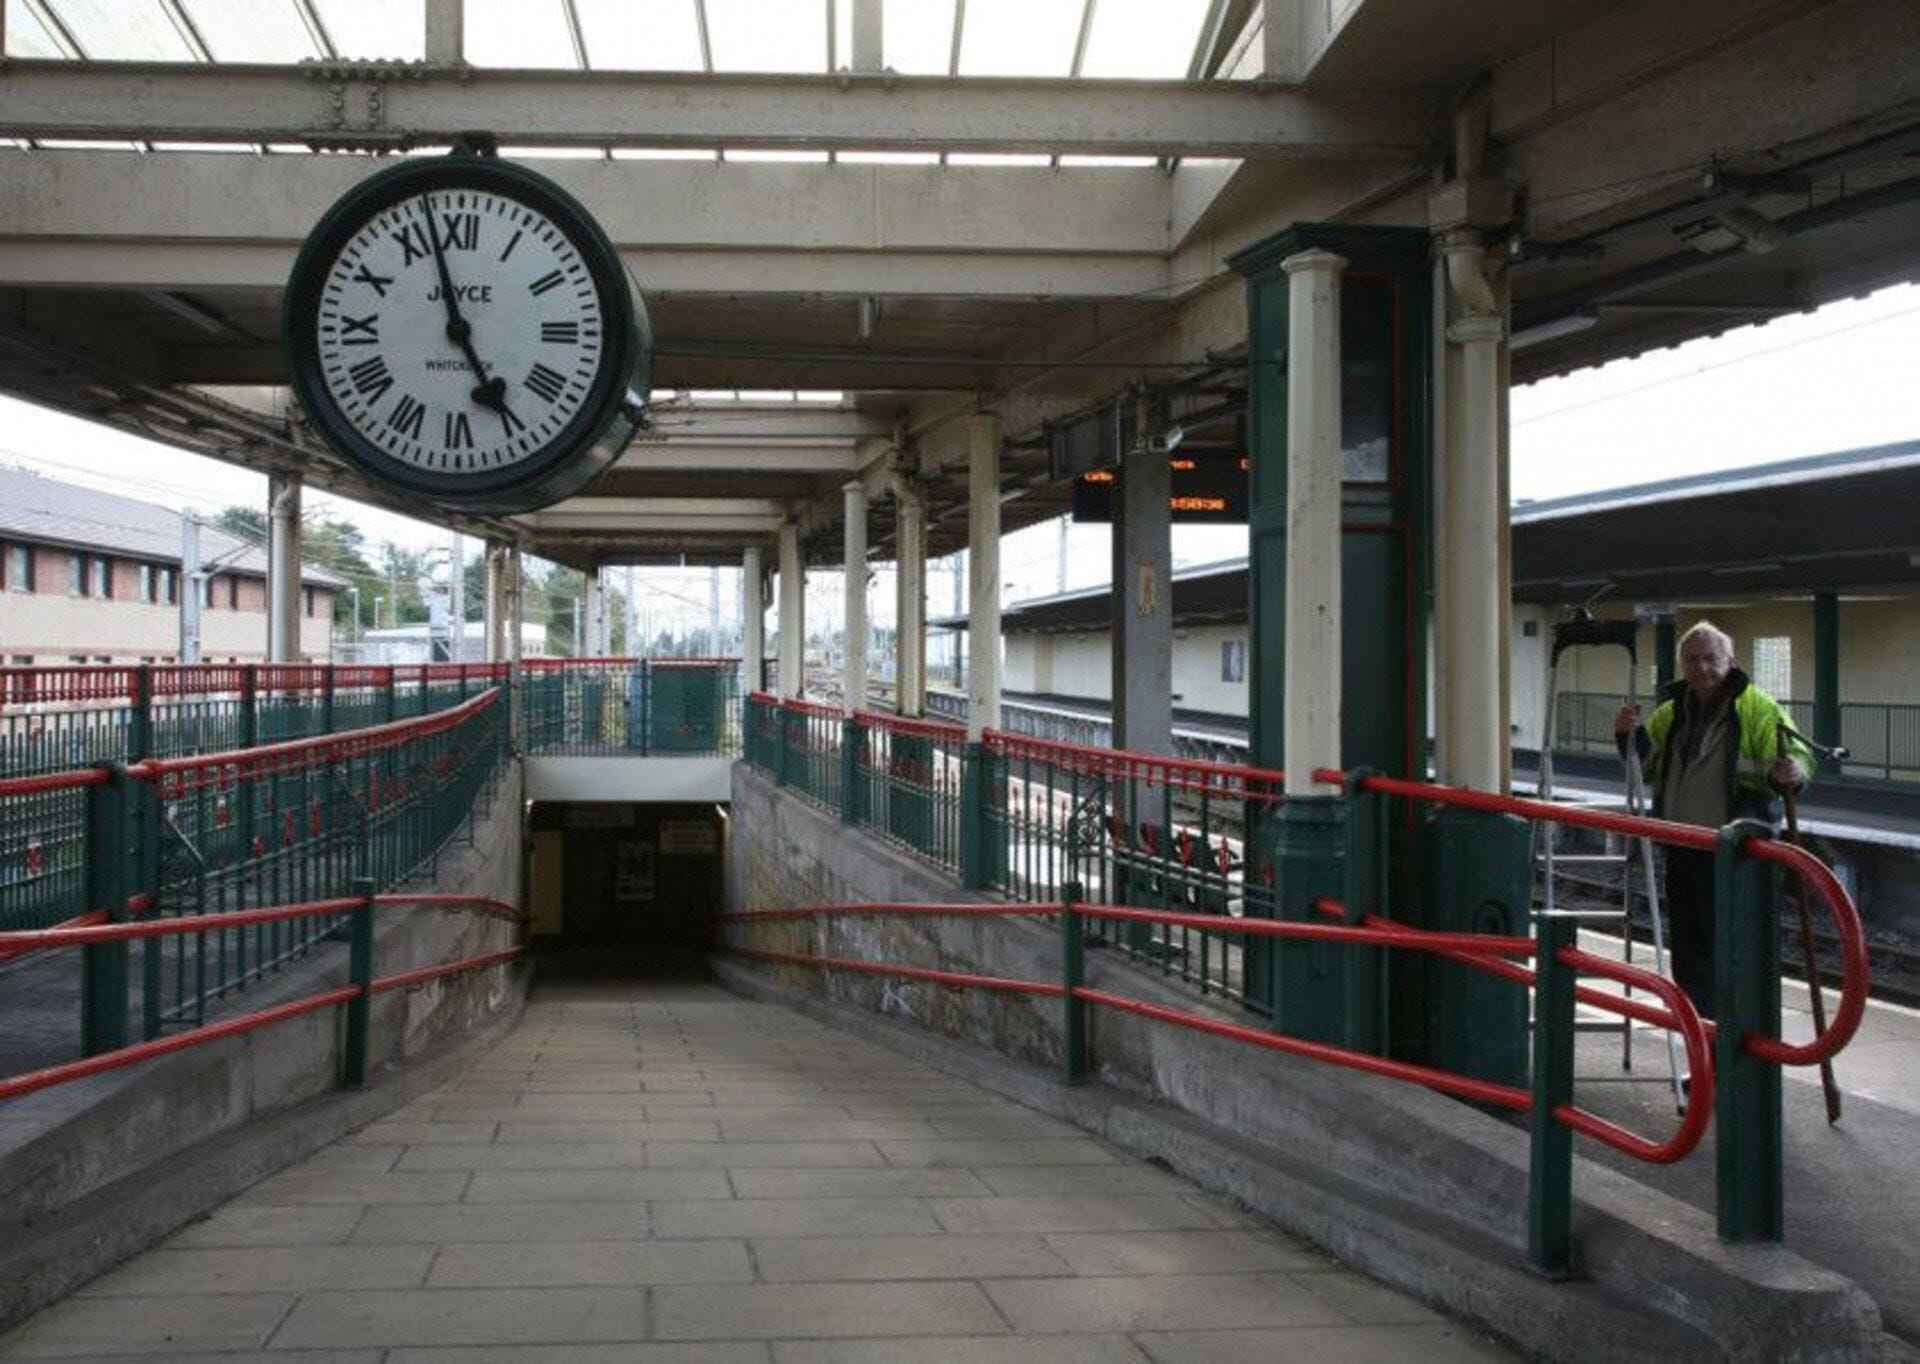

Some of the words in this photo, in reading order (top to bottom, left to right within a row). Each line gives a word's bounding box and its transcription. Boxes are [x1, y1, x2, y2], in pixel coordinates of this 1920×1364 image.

[391, 221, 432, 267] XI
[442, 213, 479, 250] XII
[501, 230, 522, 262] I
[354, 265, 394, 297] X
[529, 270, 565, 296] II
[341, 314, 378, 346] IX
[541, 321, 578, 344] III
[350, 355, 394, 406] VIII
[524, 362, 567, 403] IIII
[387, 394, 425, 441] VII
[445, 412, 474, 449] VI
